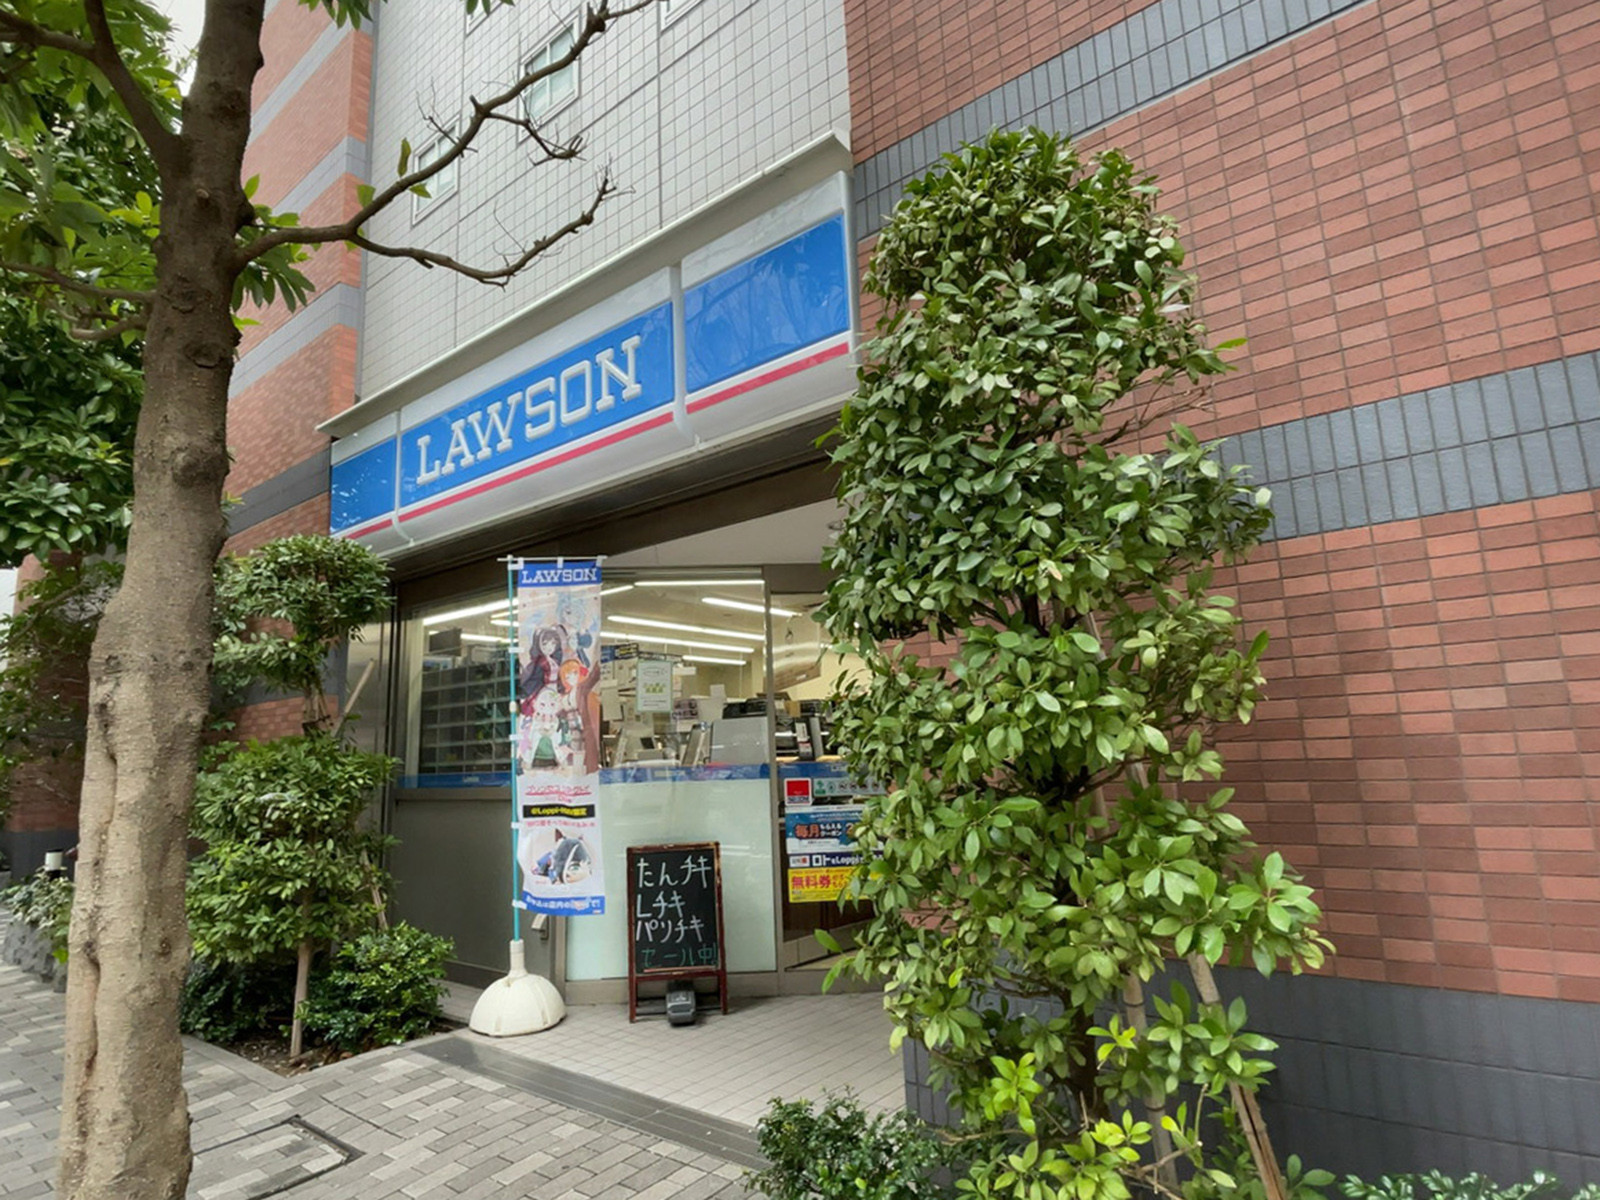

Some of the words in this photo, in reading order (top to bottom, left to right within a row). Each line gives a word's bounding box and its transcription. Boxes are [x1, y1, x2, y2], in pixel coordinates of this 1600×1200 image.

[416, 335, 641, 485] LAWSON
[522, 568, 597, 584] LAWSON
[795, 824, 820, 838] 毎月
[636, 854, 712, 889] たんチキ
[791, 874, 831, 889] 無料券
[636, 890, 686, 919] Lチキ
